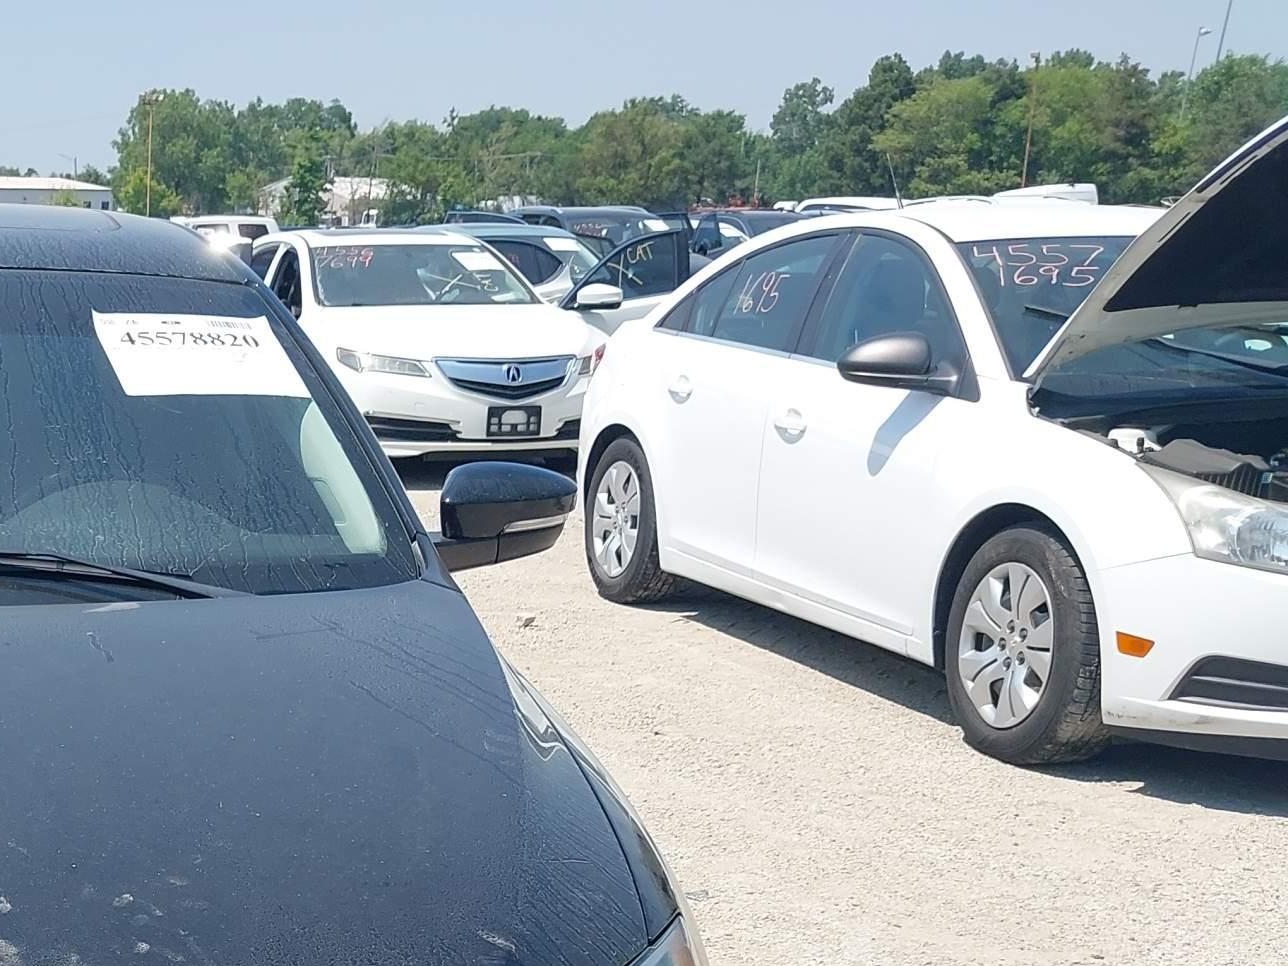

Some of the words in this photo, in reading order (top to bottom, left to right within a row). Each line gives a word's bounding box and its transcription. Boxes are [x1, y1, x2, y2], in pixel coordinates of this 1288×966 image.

[626, 241, 655, 264] CAT
[972, 243, 1105, 267] 4557
[998, 265, 1100, 287] 1695
[733, 271, 791, 316] 1695
[120, 330, 261, 349] 45578820
